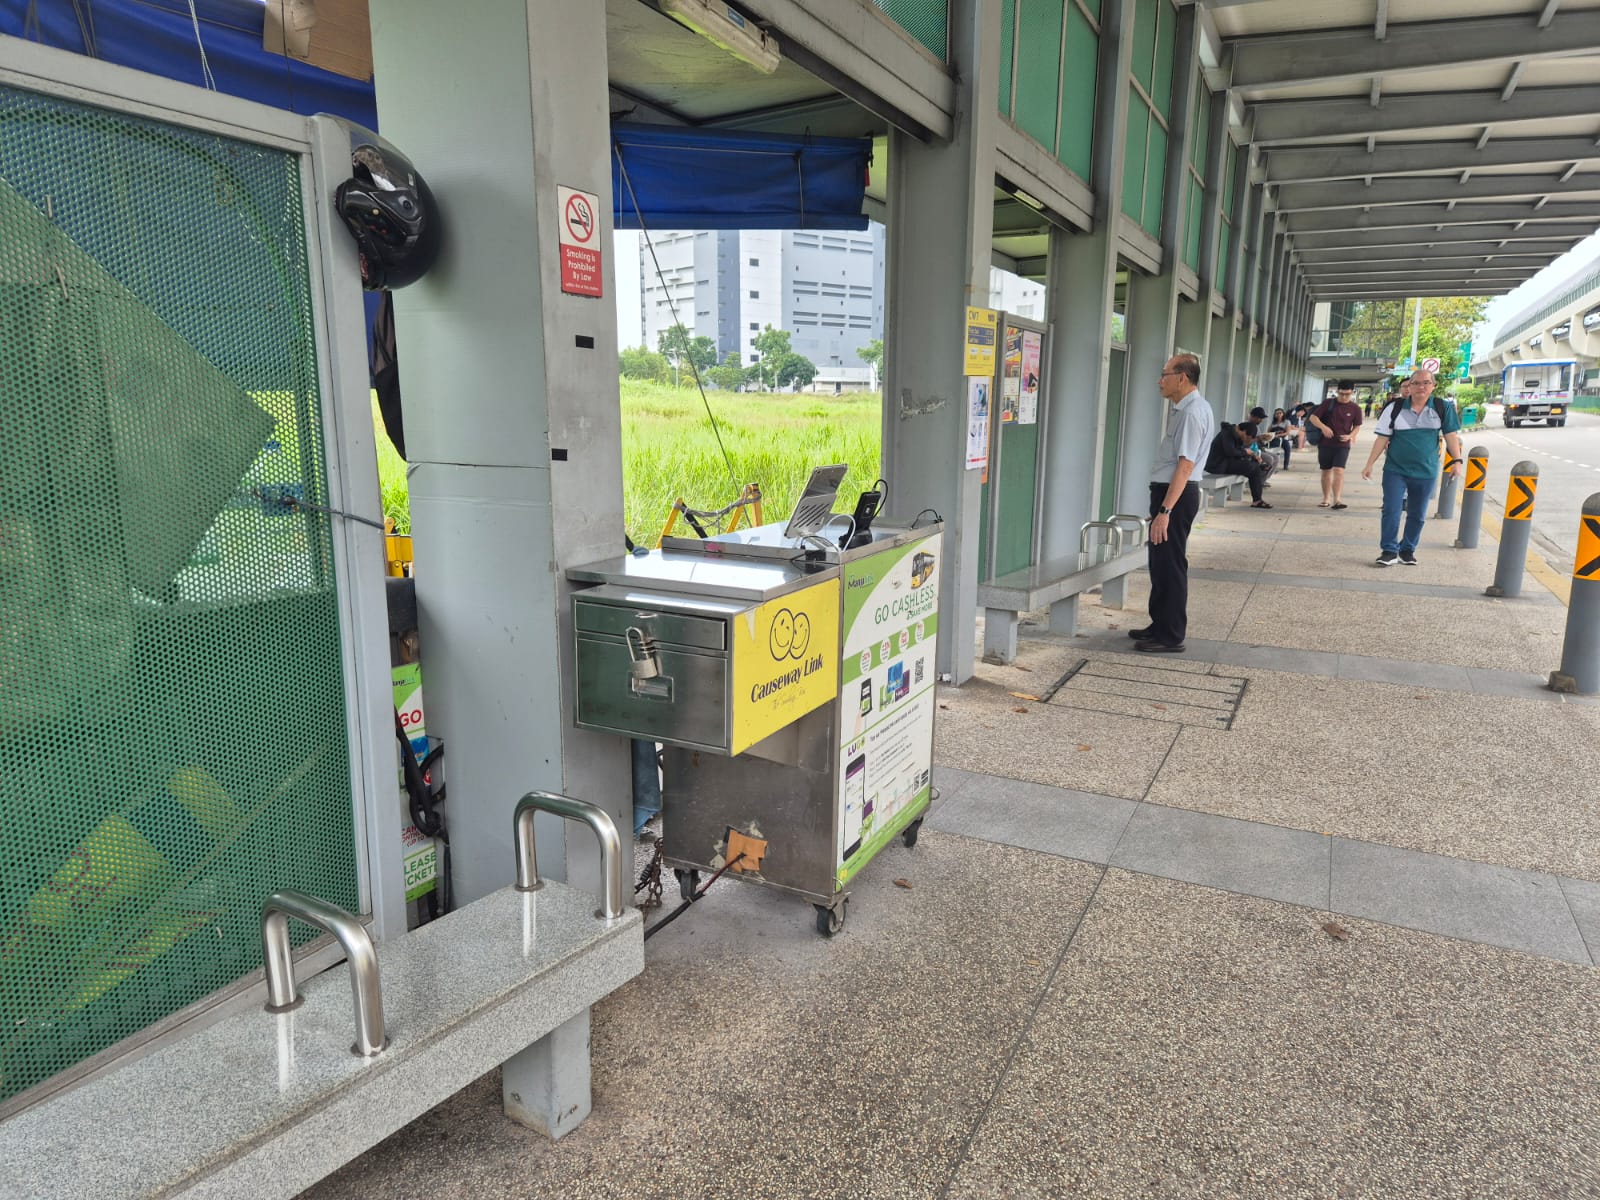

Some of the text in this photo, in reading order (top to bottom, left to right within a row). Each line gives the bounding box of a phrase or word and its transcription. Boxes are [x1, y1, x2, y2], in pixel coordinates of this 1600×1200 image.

[566, 249, 591, 262] Smoking
[568, 260, 596, 272] Prohibited
[572, 271, 592, 282] By Law
[874, 583, 935, 625] GO CASHLESS
[751, 667, 803, 703] Causeway
[804, 654, 824, 677] Link
[399, 709, 422, 727] GO
[403, 851, 437, 875] LEASE
[404, 862, 437, 887] ICKET
